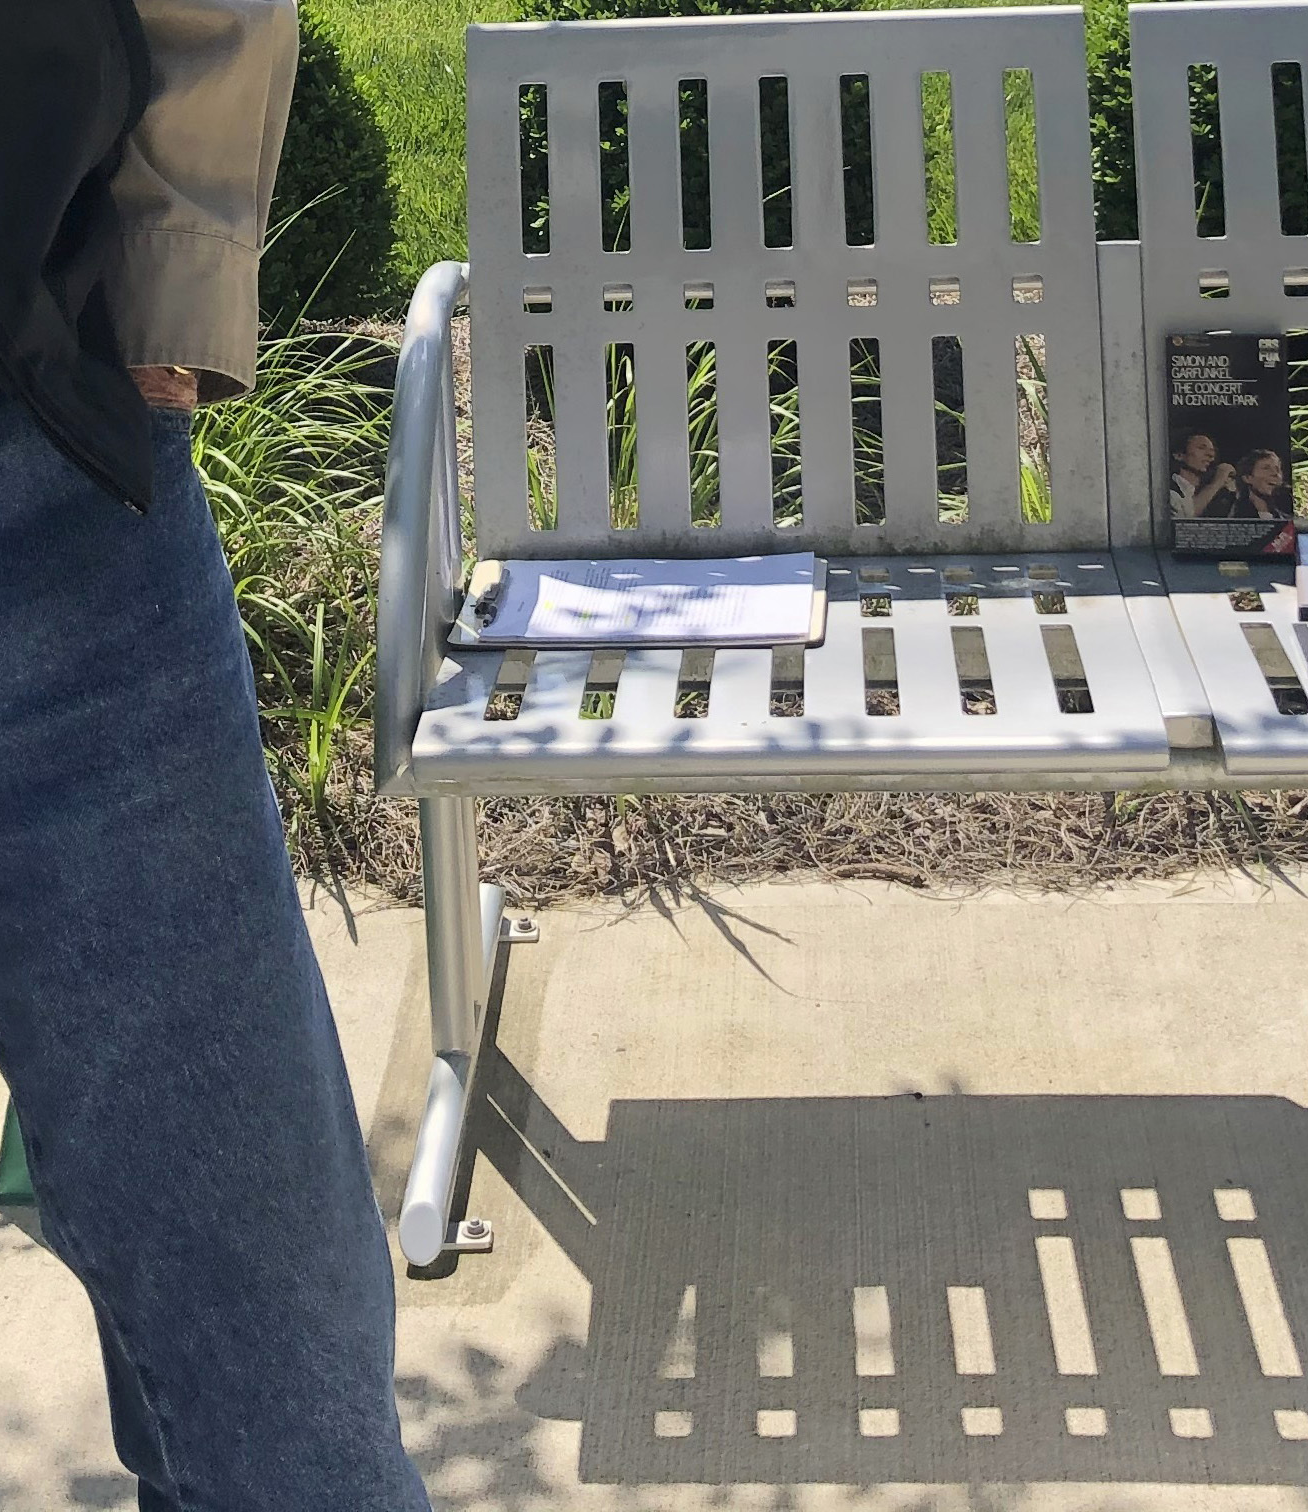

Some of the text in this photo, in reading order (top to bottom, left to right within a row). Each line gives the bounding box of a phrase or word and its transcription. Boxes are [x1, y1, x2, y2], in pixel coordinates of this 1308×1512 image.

[1171, 355, 1230, 367] SIMON AND
[1171, 368, 1233, 379] GARFUNKEL
[1173, 383, 1243, 394] THE CONCERT
[1173, 395, 1259, 407] IN CENTRAL PARK
